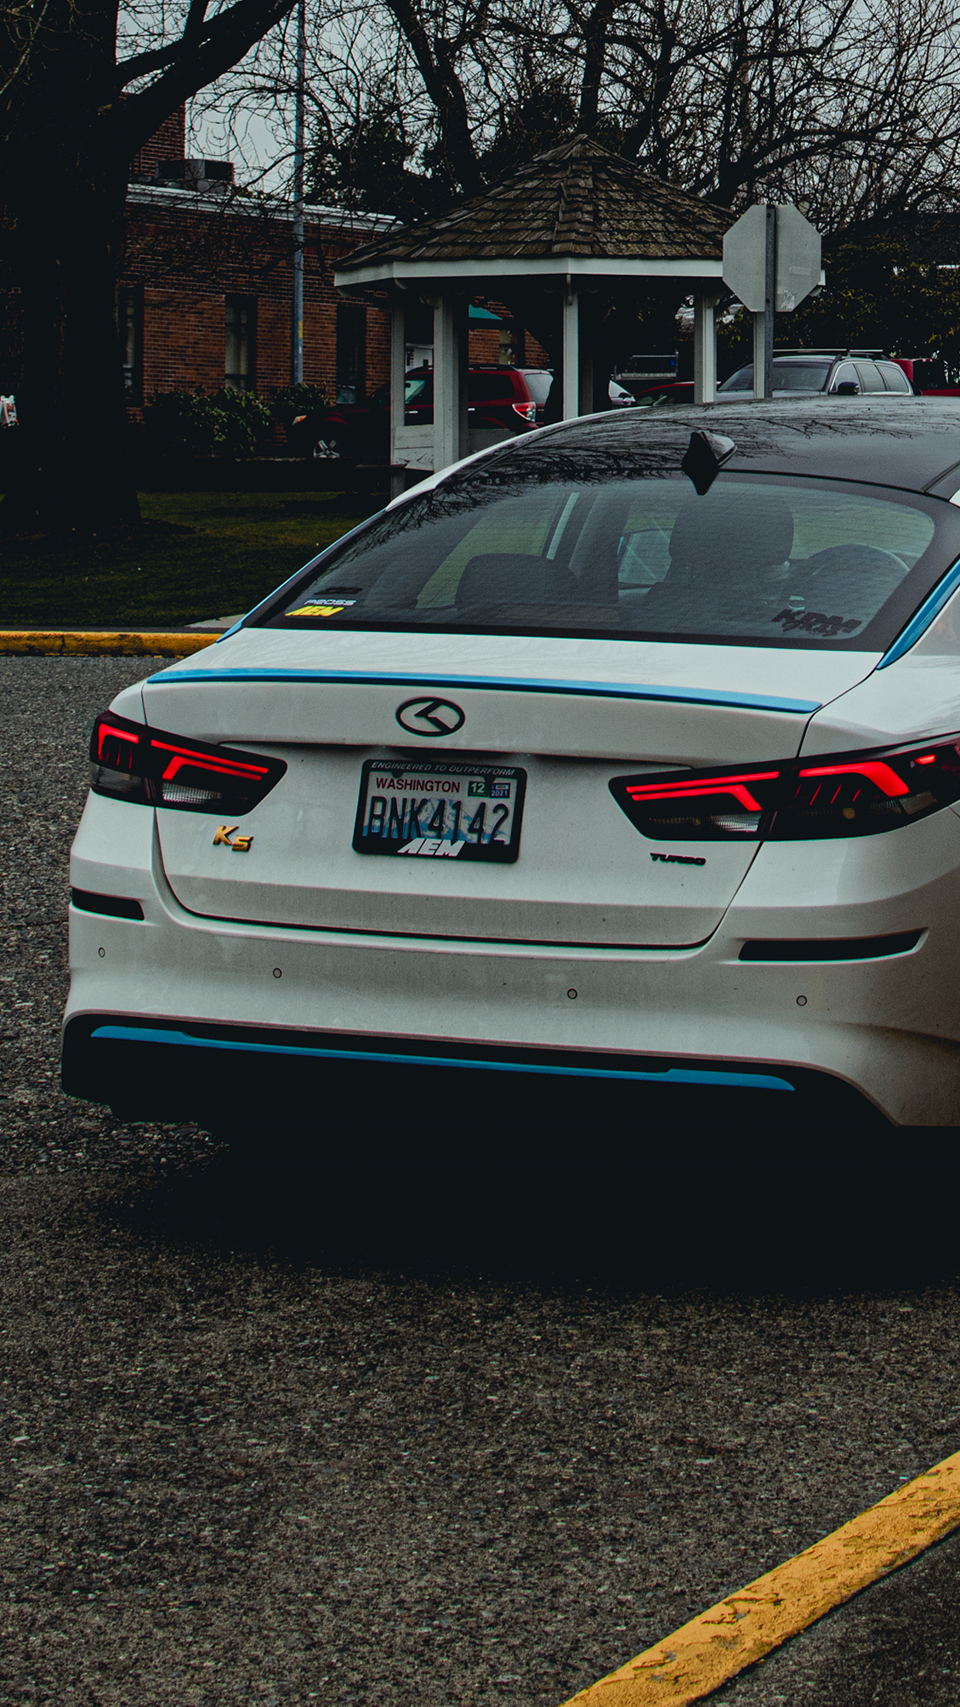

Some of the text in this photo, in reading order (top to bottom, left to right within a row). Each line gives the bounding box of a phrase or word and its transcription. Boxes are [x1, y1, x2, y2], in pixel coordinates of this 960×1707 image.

[371, 761, 516, 776] ENGINEERED TO OUTPERFORM
[376, 777, 485, 793] WASHINGTON 12
[490, 789, 509, 797] 2021
[368, 795, 510, 845] BNK4142
[397, 837, 467, 857] AEM
